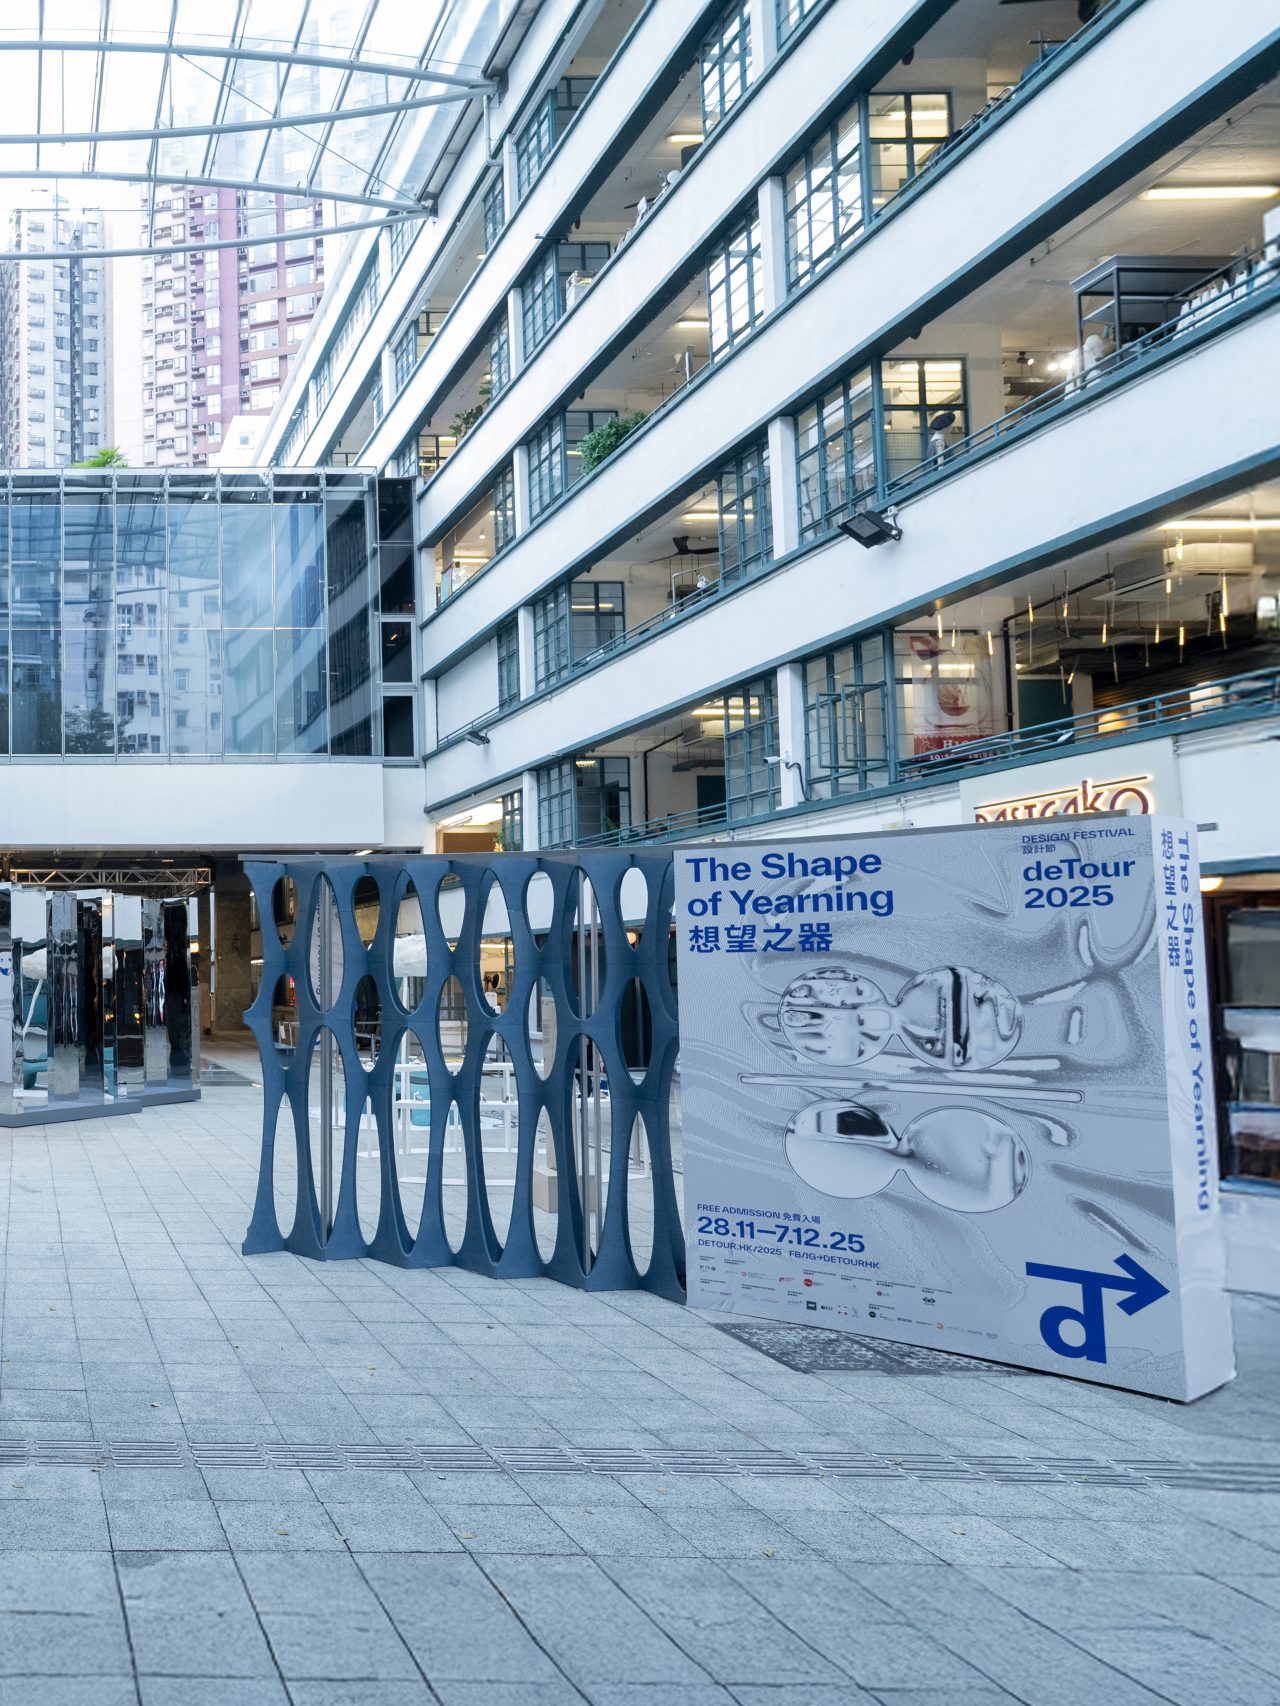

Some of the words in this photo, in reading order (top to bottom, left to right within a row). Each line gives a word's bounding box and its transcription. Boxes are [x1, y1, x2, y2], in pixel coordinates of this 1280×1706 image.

[1022, 831, 1069, 844] DESIGN
[1073, 828, 1135, 840] FESTIVAL
[1023, 844, 1056, 855] 設計節
[685, 857, 752, 883] The
[761, 852, 882, 882] Shape
[1023, 859, 1136, 882] deTour
[1178, 831, 1190, 893] The
[687, 891, 722, 917] of
[729, 885, 894, 917] Yearning
[1024, 885, 1114, 909] 2025
[1161, 829, 1180, 967] 想望之器
[688, 922, 833, 954] 想望之器
[1182, 903, 1196, 1010] Shape
[1189, 1018, 1201, 1053] of
[1191, 1061, 1210, 1211] Yearning
[697, 1203, 720, 1213] FREE
[722, 1206, 781, 1220] ADMISSION
[782, 1211, 821, 1225] 免費入場
[697, 1239, 782, 1256] DETOUR.HK/2025
